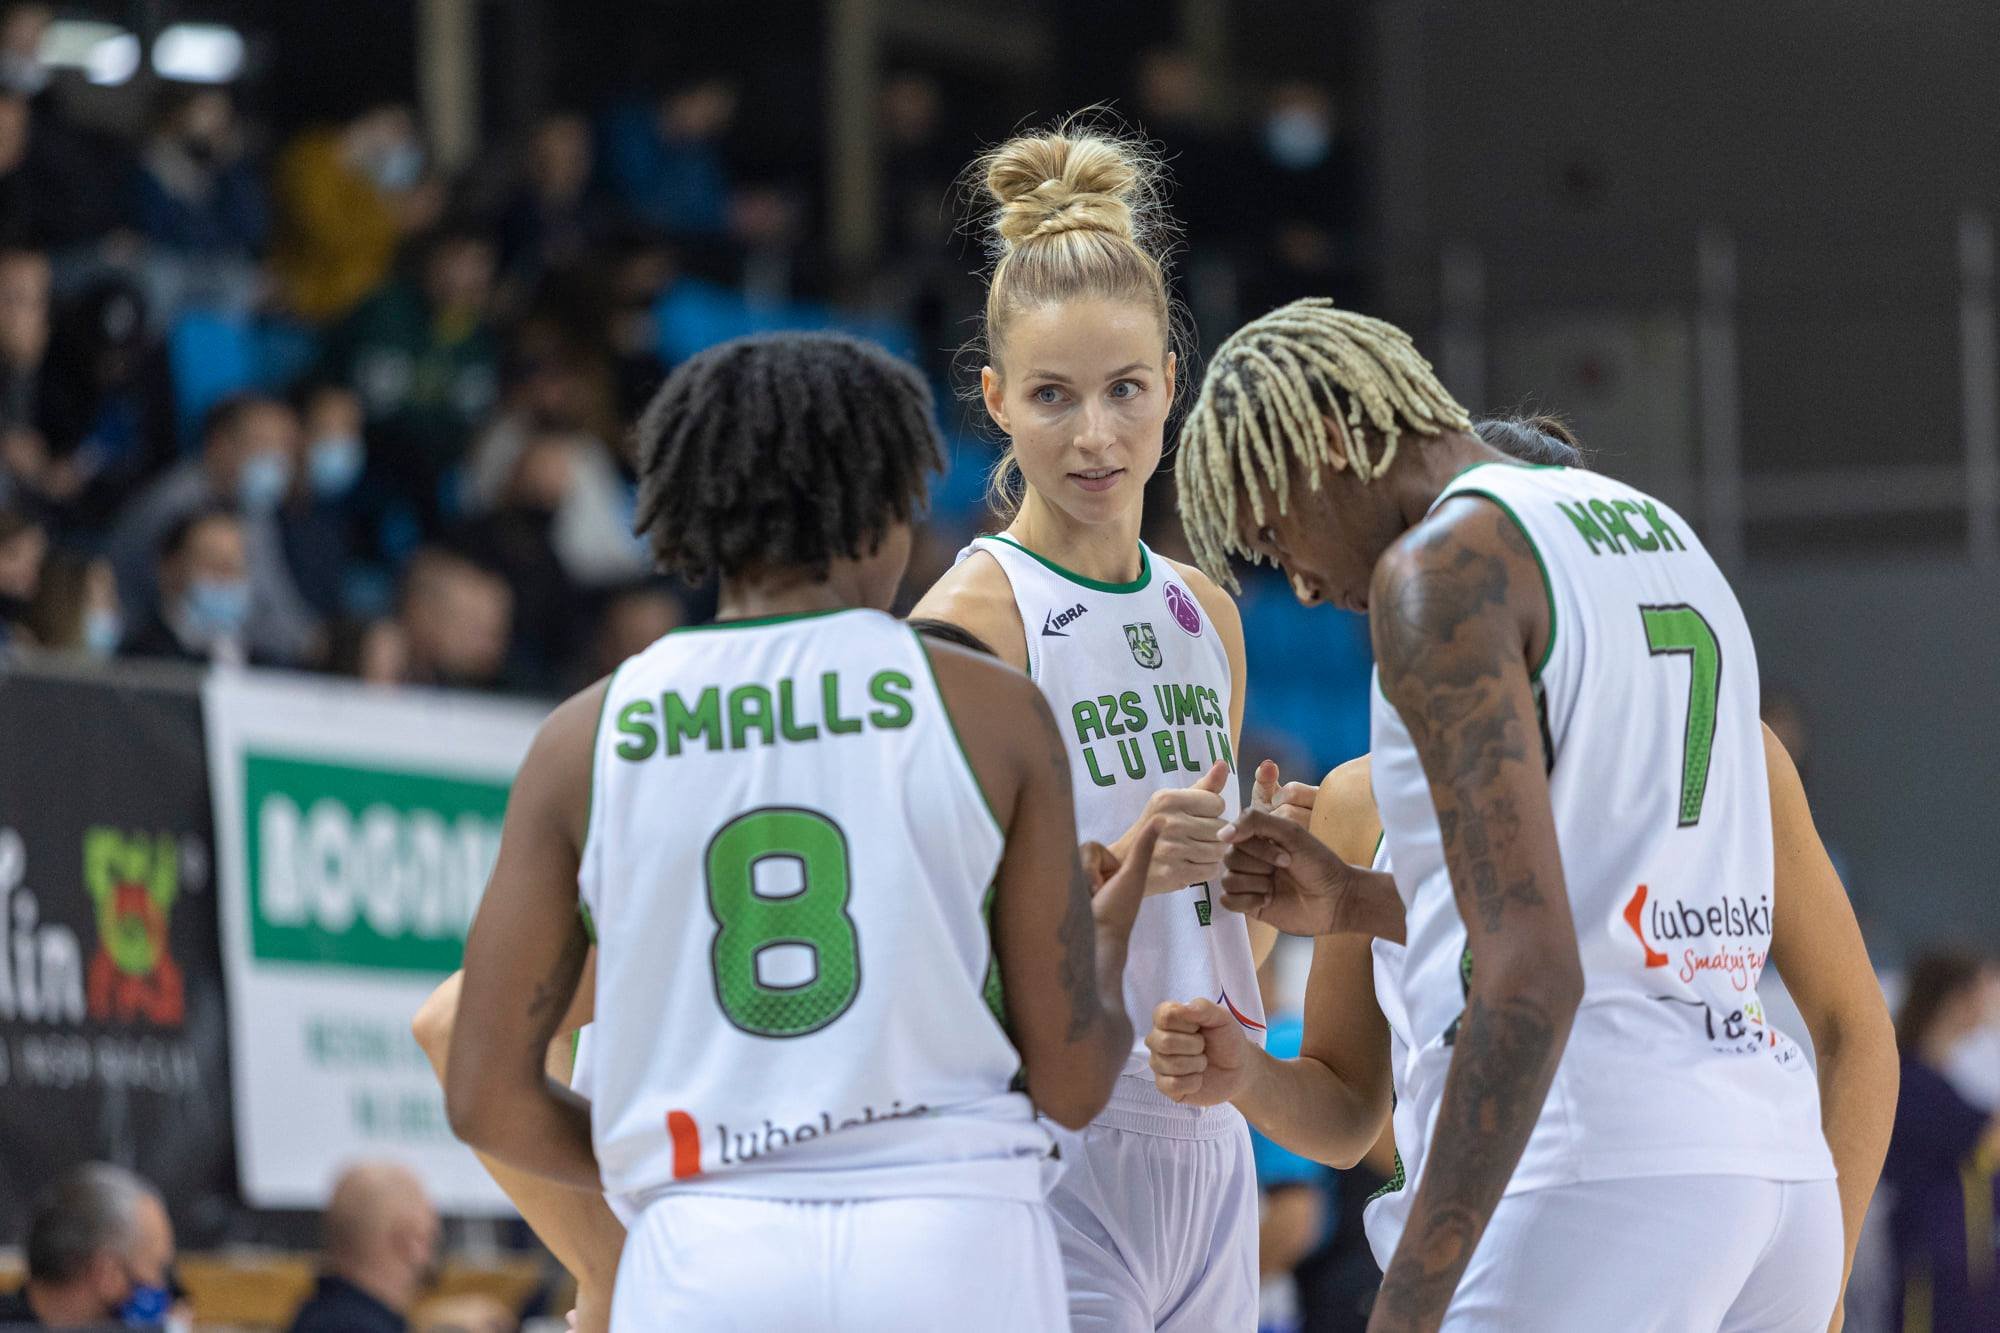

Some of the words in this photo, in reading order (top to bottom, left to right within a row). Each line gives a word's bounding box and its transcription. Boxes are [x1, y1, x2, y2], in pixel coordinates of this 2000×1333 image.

[1556, 498, 1686, 556] MACK
[614, 669, 914, 763] SMALLS
[1072, 691, 1148, 744] AZS
[1153, 684, 1224, 728] UMCS
[1638, 602, 1722, 827] 7
[1083, 730, 1237, 787] LUBLIN
[705, 804, 862, 1041] 8
